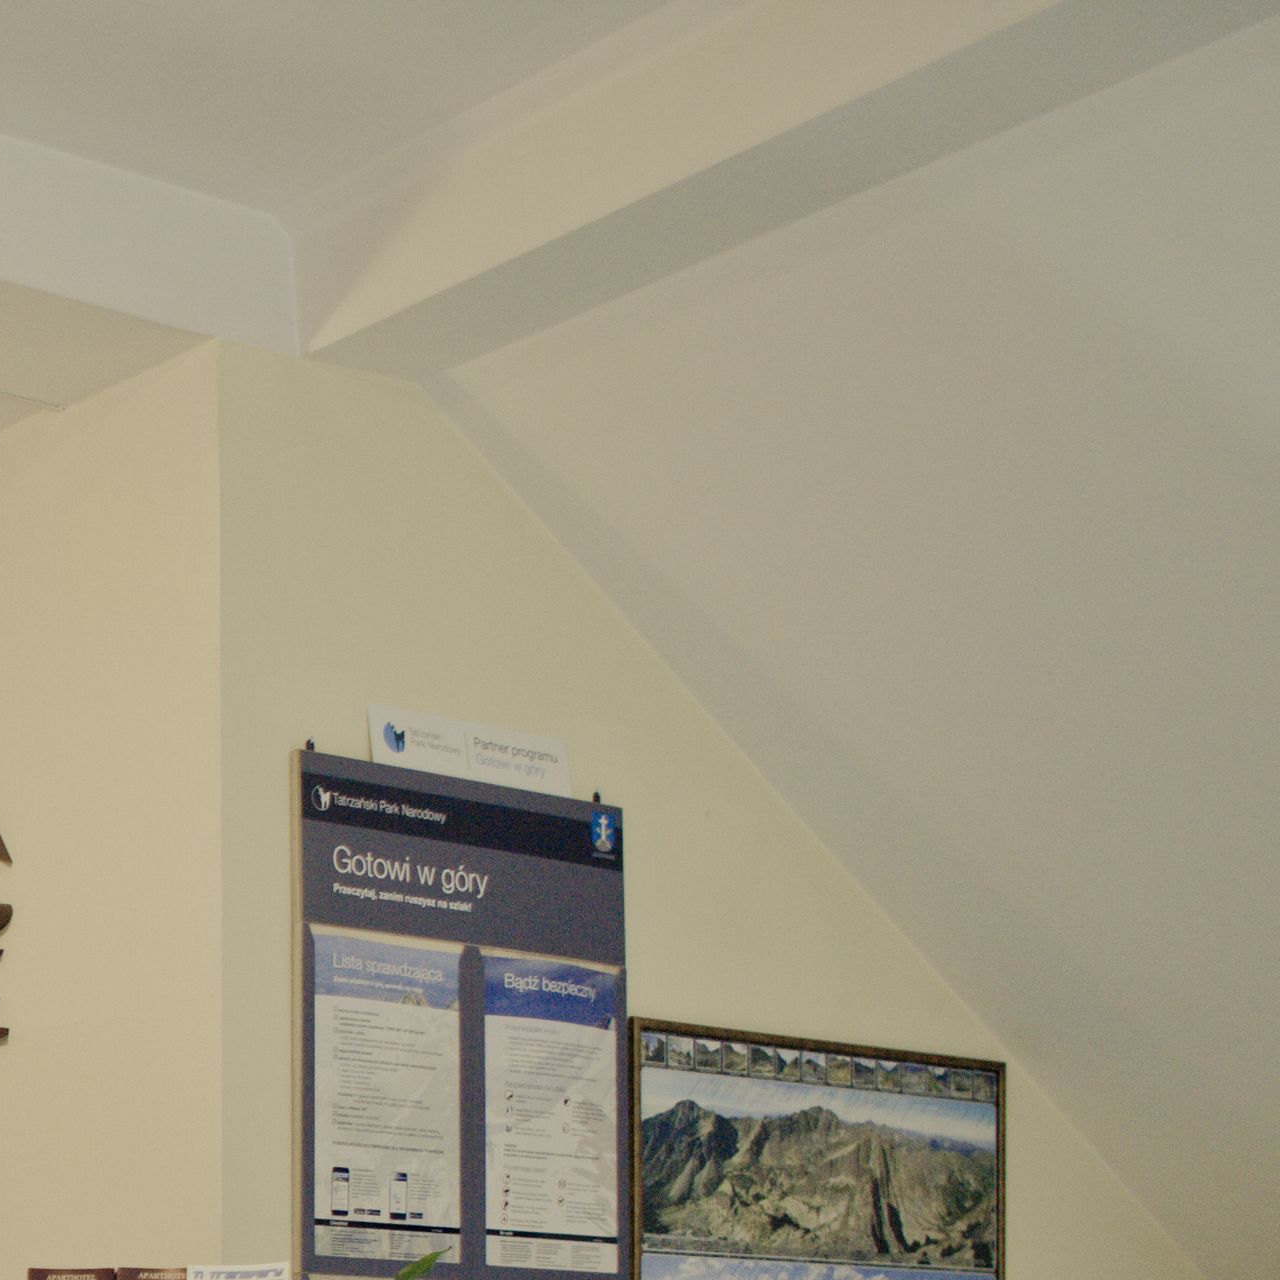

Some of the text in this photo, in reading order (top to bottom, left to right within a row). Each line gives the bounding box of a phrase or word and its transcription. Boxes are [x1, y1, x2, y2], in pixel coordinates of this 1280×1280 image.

[473, 736, 558, 764] Partner programu
[332, 792, 447, 825] Tatrzański Park Narodowy
[333, 845, 489, 899] Gotowi w góry
[332, 882, 377, 900] Przeczytaj,
[378, 891, 404, 903] zanim
[404, 894, 436, 908] ruszysz
[437, 899, 448, 909] na
[332, 952, 443, 983] Lista sprawdzająca
[503, 972, 596, 1002] Bądź bezpieczny
[138, 1272, 186, 1280] APARTHOTE
